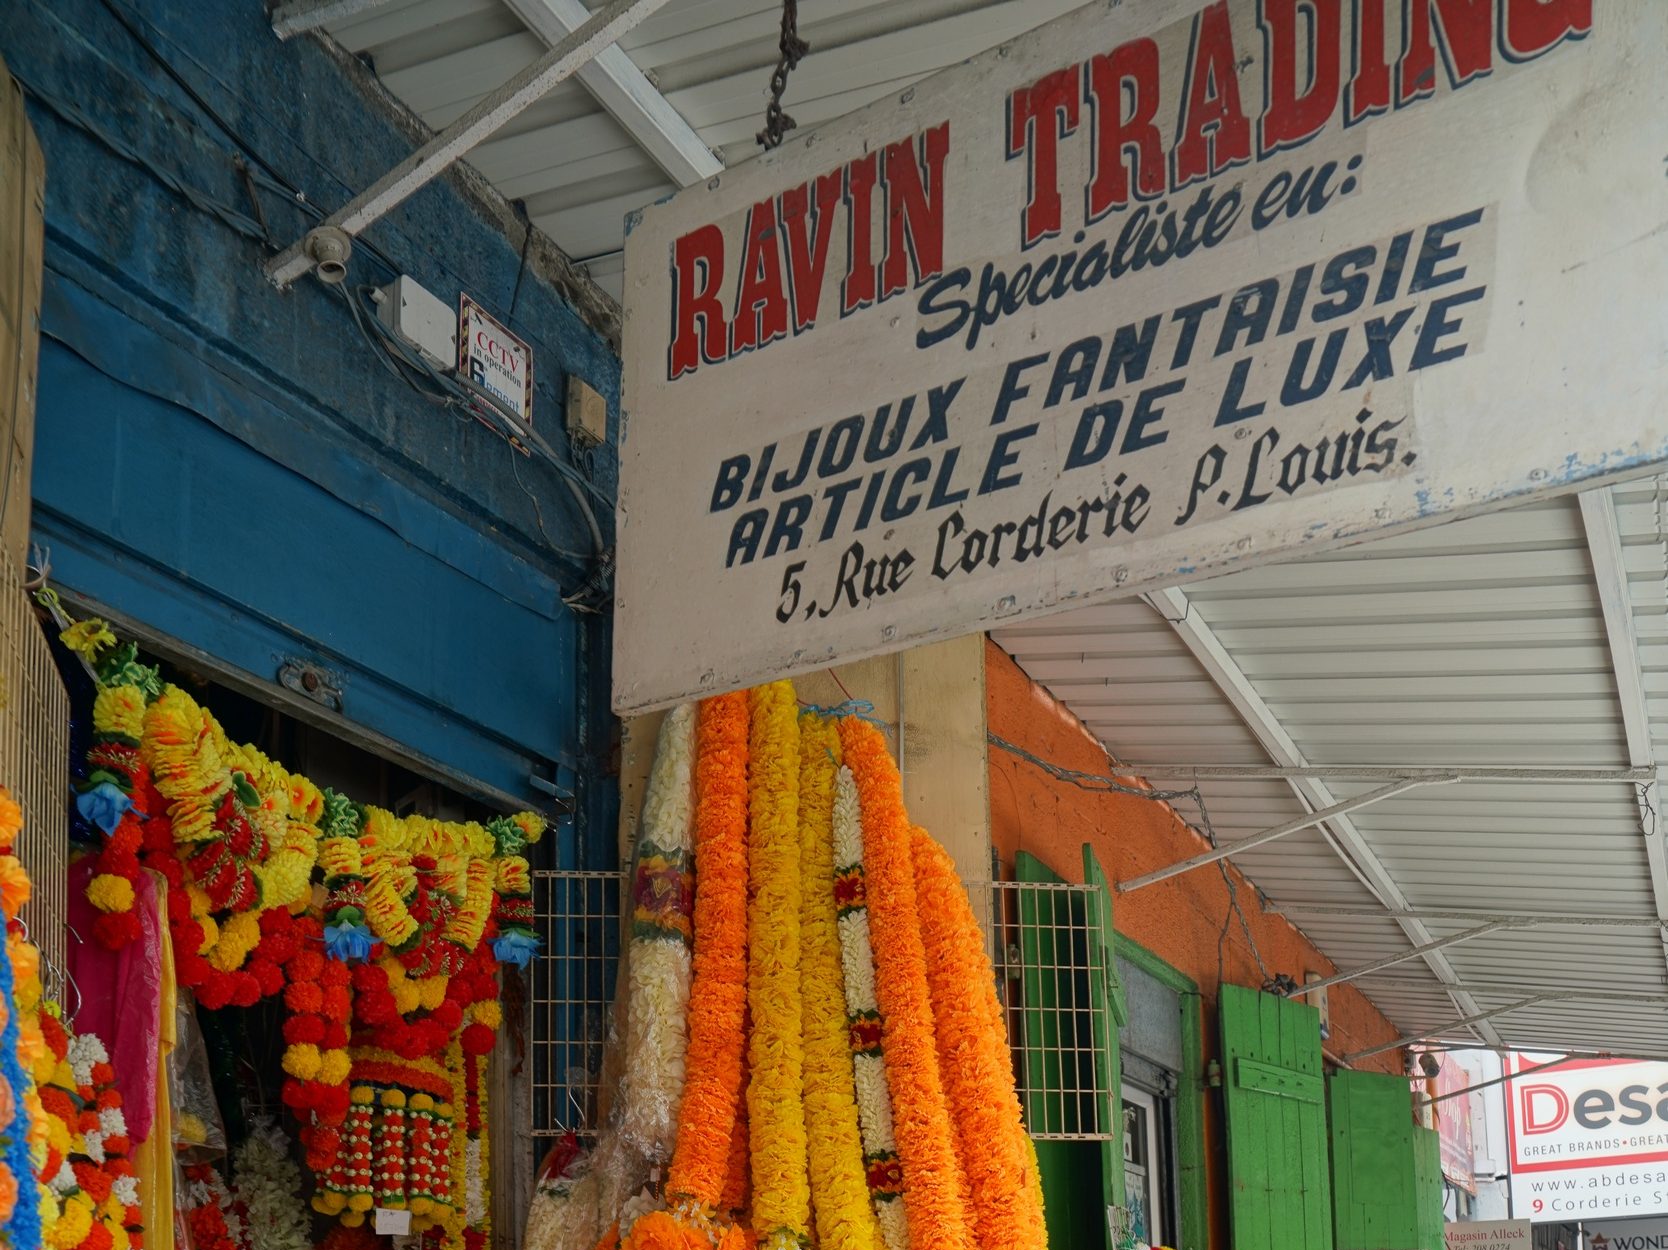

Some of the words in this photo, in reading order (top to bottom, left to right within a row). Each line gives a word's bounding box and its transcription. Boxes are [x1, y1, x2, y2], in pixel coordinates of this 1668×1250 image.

[667, 119, 949, 381] RAVIN
[916, 186, 1246, 351] Specialiste
[1251, 154, 1363, 231] en:
[473, 344, 483, 358] in
[484, 354, 521, 390] operation
[477, 331, 519, 373] CCTV
[710, 376, 968, 513] BIJOUX
[990, 207, 1486, 426] FANTAISIE
[725, 422, 1040, 569] ARTICLE
[1063, 377, 1187, 472] DE
[1213, 285, 1487, 428] LUXE
[931, 473, 1150, 580] Corderie
[1523, 1143, 1562, 1156] GREAT
[1443, 1230, 1487, 1243] Magasin
[1490, 1228, 1525, 1240] Alleck
[1532, 1199, 1543, 1213] 9
[1551, 1194, 1642, 1211] Corderie
